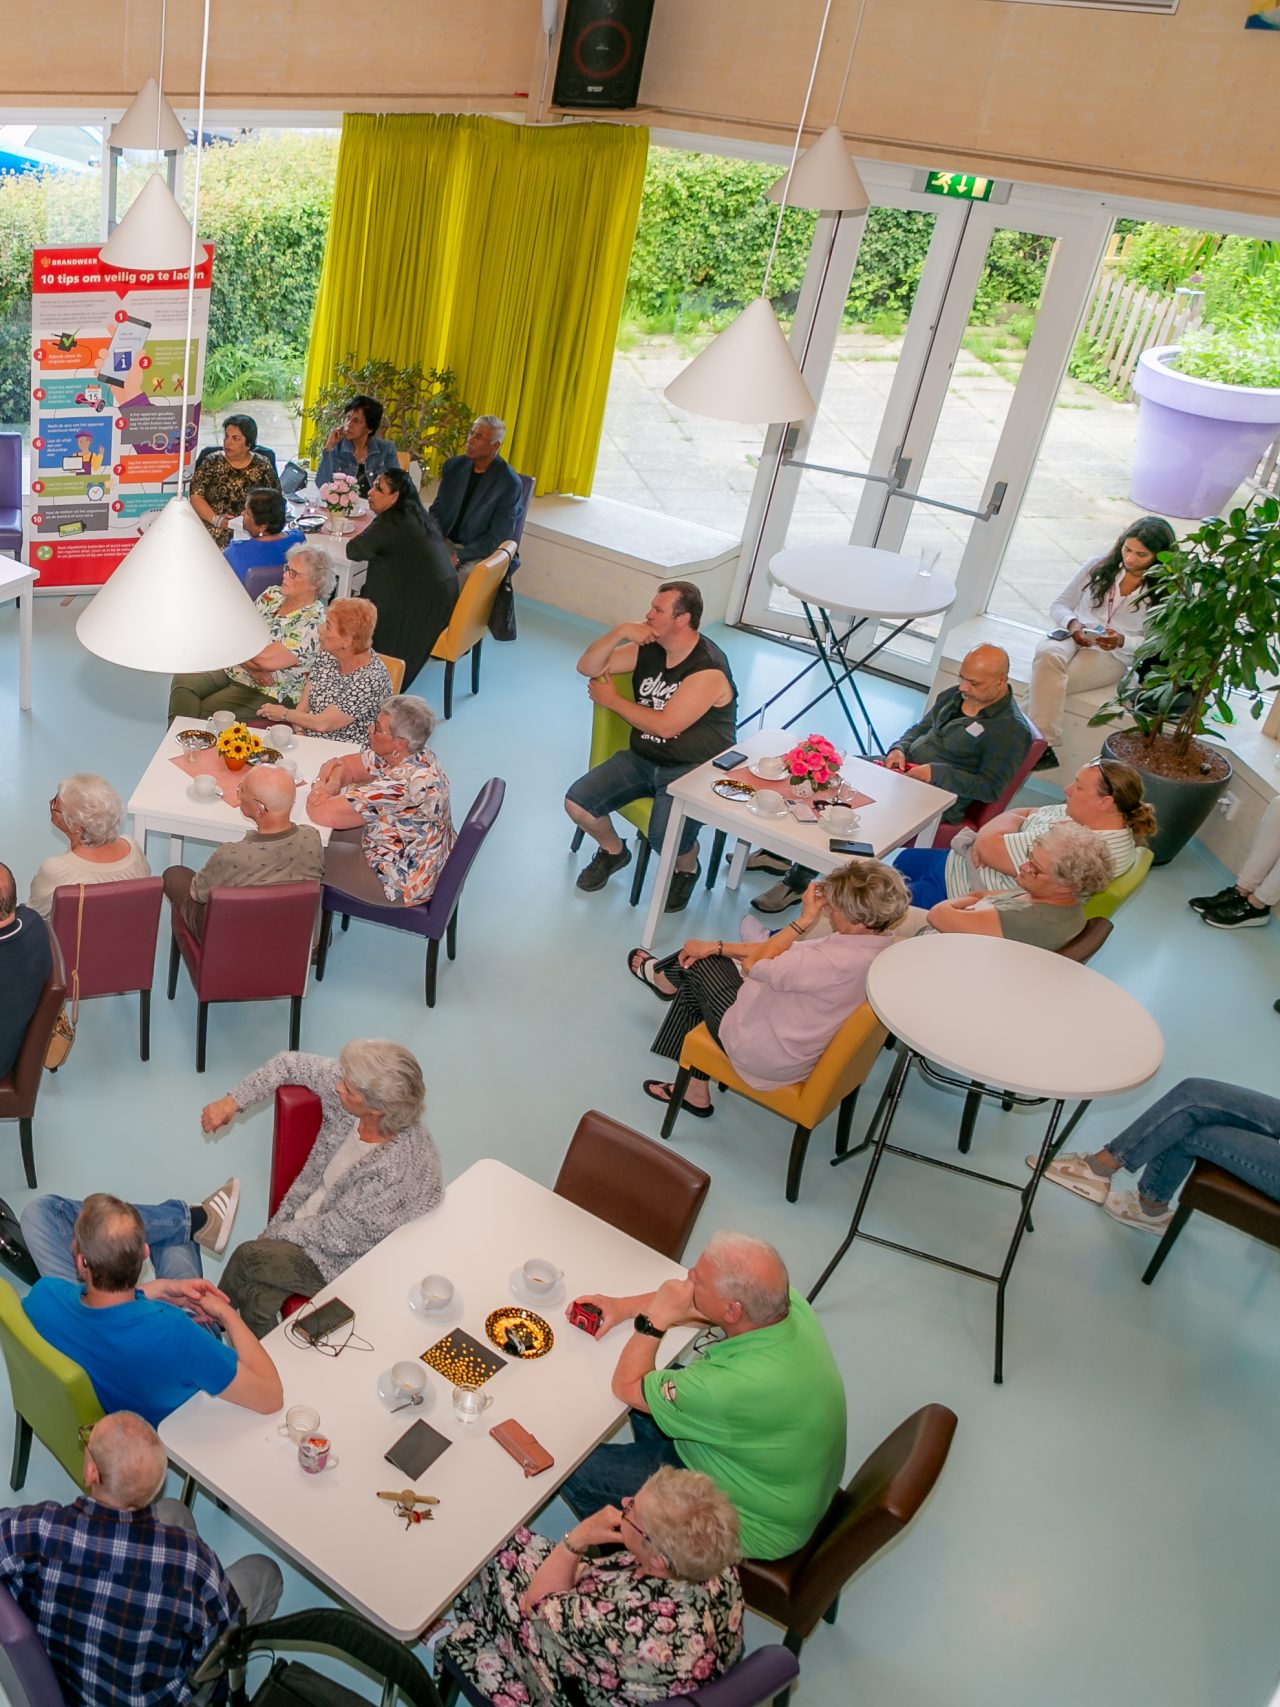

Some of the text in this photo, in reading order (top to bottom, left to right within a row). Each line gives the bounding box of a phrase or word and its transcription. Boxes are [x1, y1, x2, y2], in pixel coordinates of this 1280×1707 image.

[51, 257, 98, 266] BRANDWEER
[40, 270, 205, 286] 10 tips om veilig op te ladn
[88, 393, 99, 401] 15
